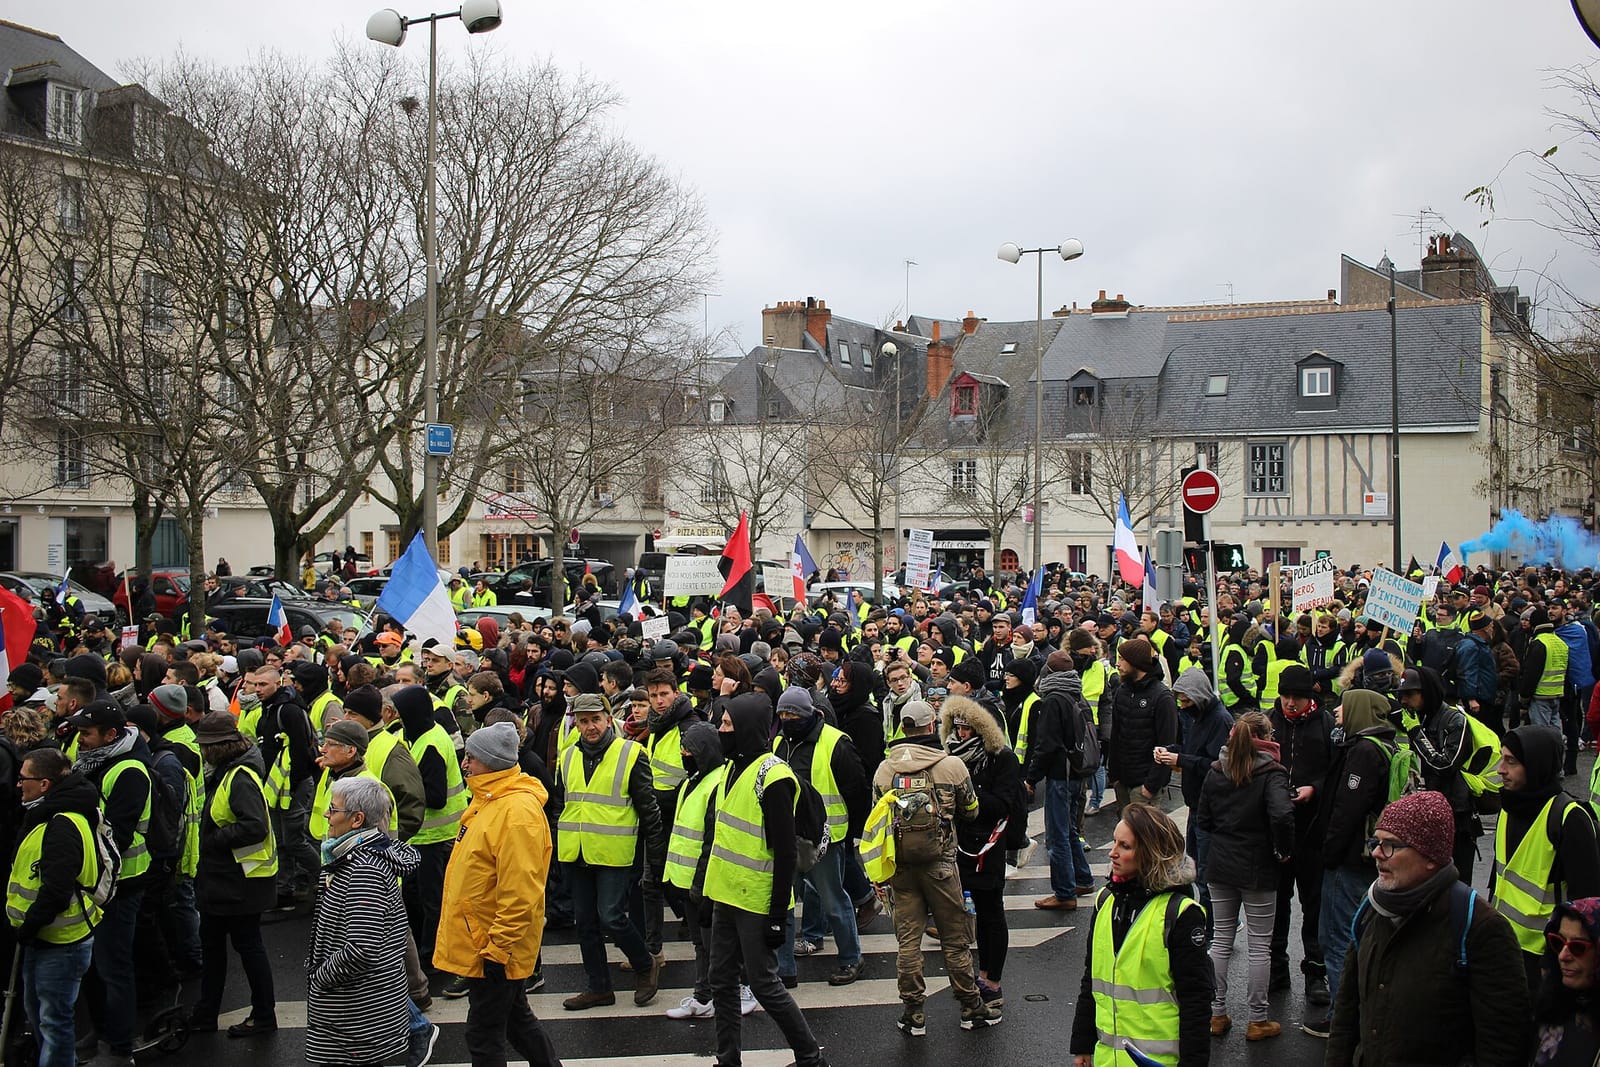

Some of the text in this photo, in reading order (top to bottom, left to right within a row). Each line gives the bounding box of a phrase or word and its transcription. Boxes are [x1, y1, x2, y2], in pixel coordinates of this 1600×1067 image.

[677, 528, 695, 536] PIZZA
[697, 528, 710, 536] DES
[1293, 557, 1333, 581] POLICIERS
[700, 582, 708, 590] ET
[1294, 583, 1315, 597] HEROS
[1374, 568, 1424, 597] REFERENDUM
[1366, 602, 1414, 634] CITOYENNE
